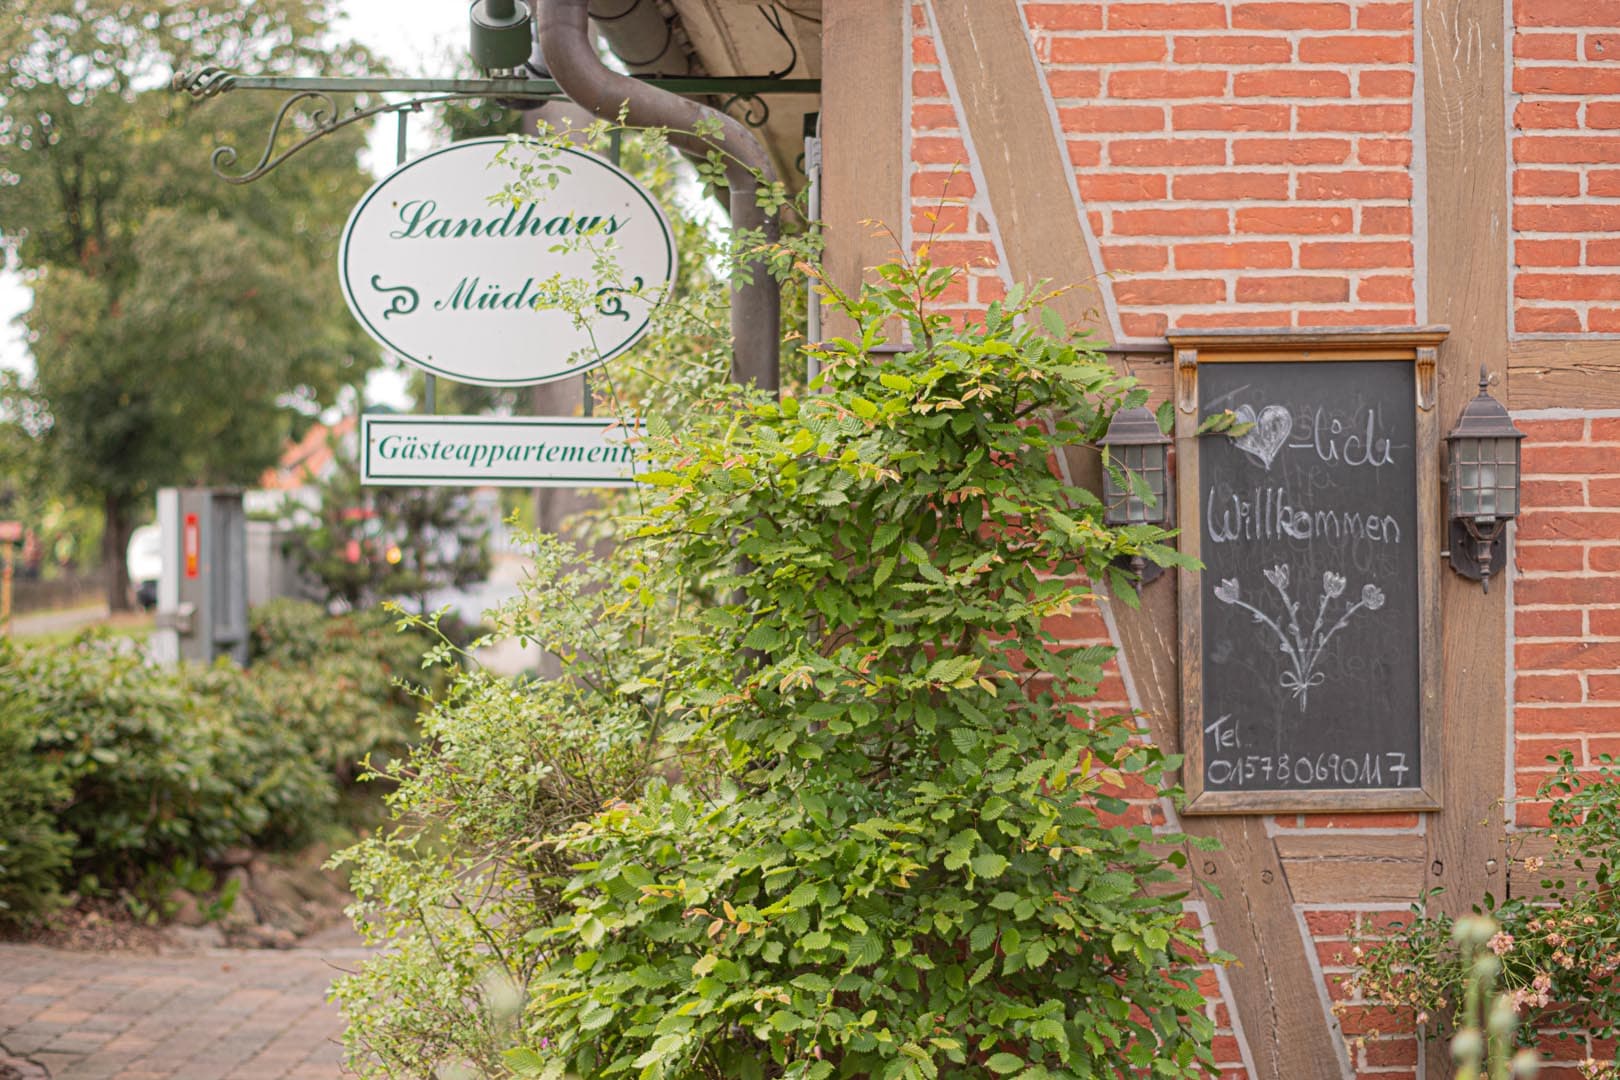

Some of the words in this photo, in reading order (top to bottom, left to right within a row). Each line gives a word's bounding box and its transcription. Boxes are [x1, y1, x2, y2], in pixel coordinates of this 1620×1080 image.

[389, 199, 632, 240] Landhaus
[433, 276, 562, 312] Müde
[1207, 486, 1401, 544] Willkommen
